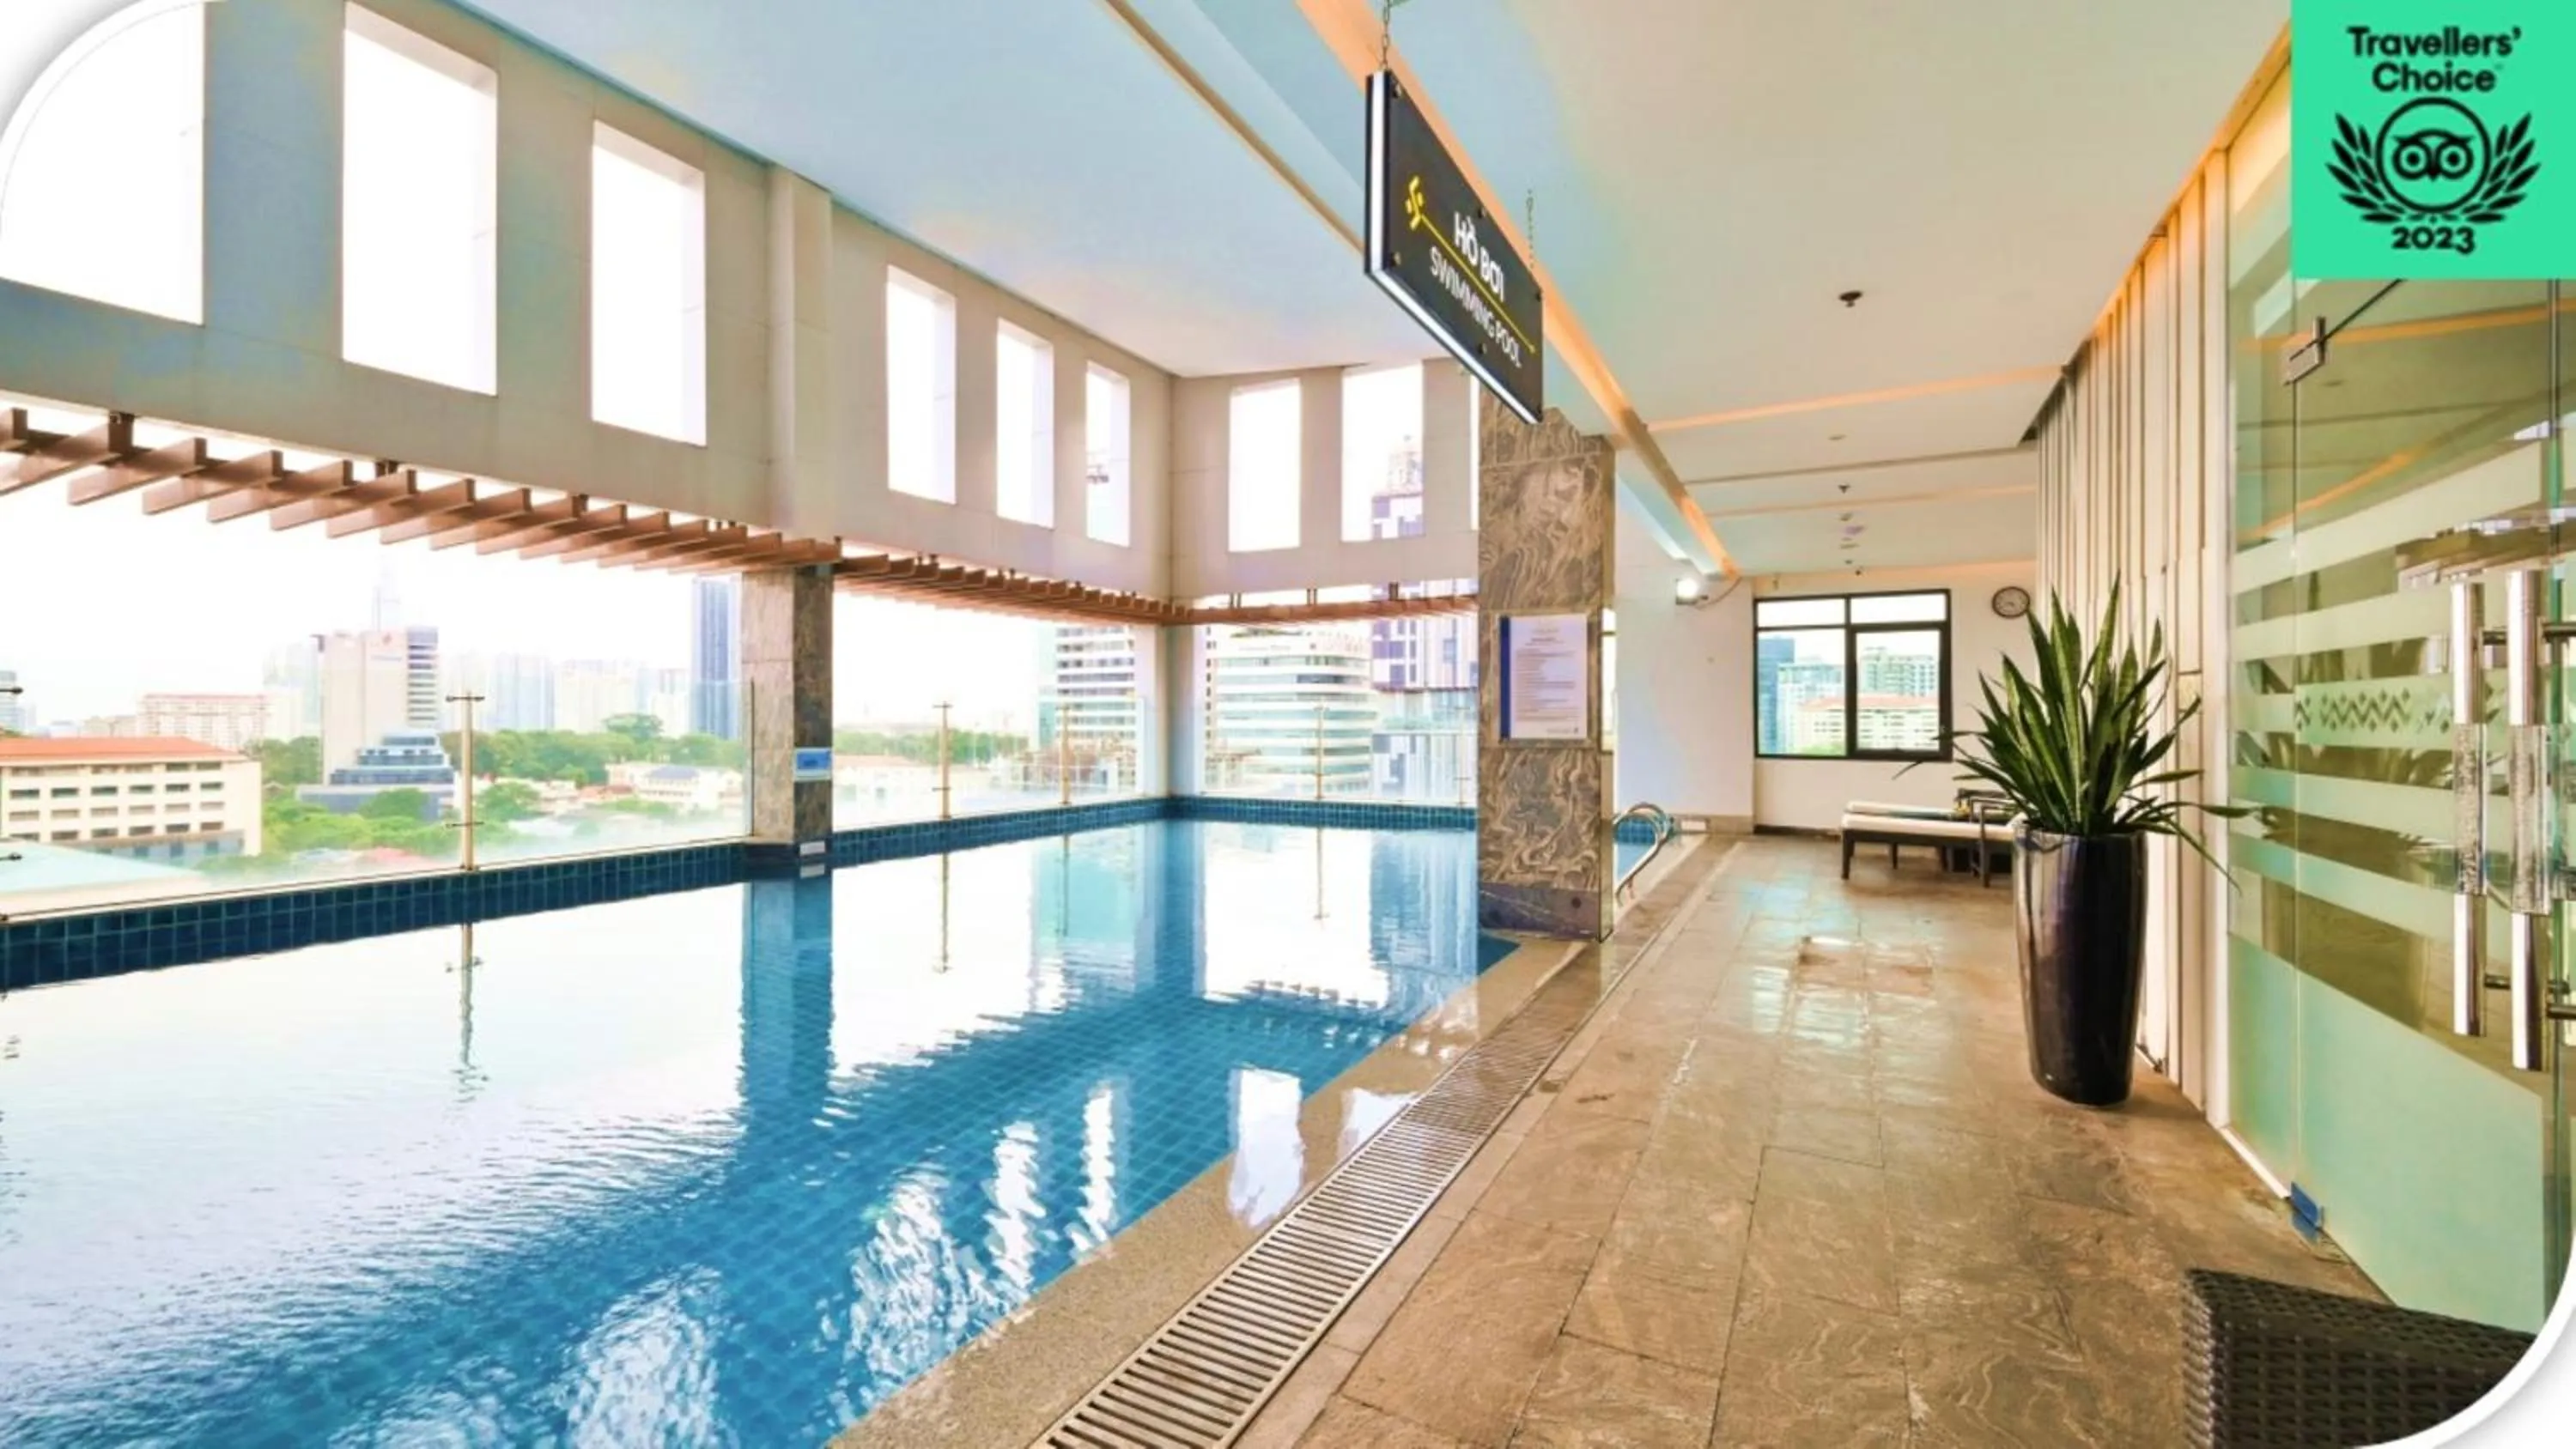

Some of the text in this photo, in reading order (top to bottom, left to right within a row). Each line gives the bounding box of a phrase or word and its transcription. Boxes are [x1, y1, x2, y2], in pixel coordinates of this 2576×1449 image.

[1454, 211, 1479, 267] HỒ
[1429, 246, 1522, 368] SWIMMING POOL
